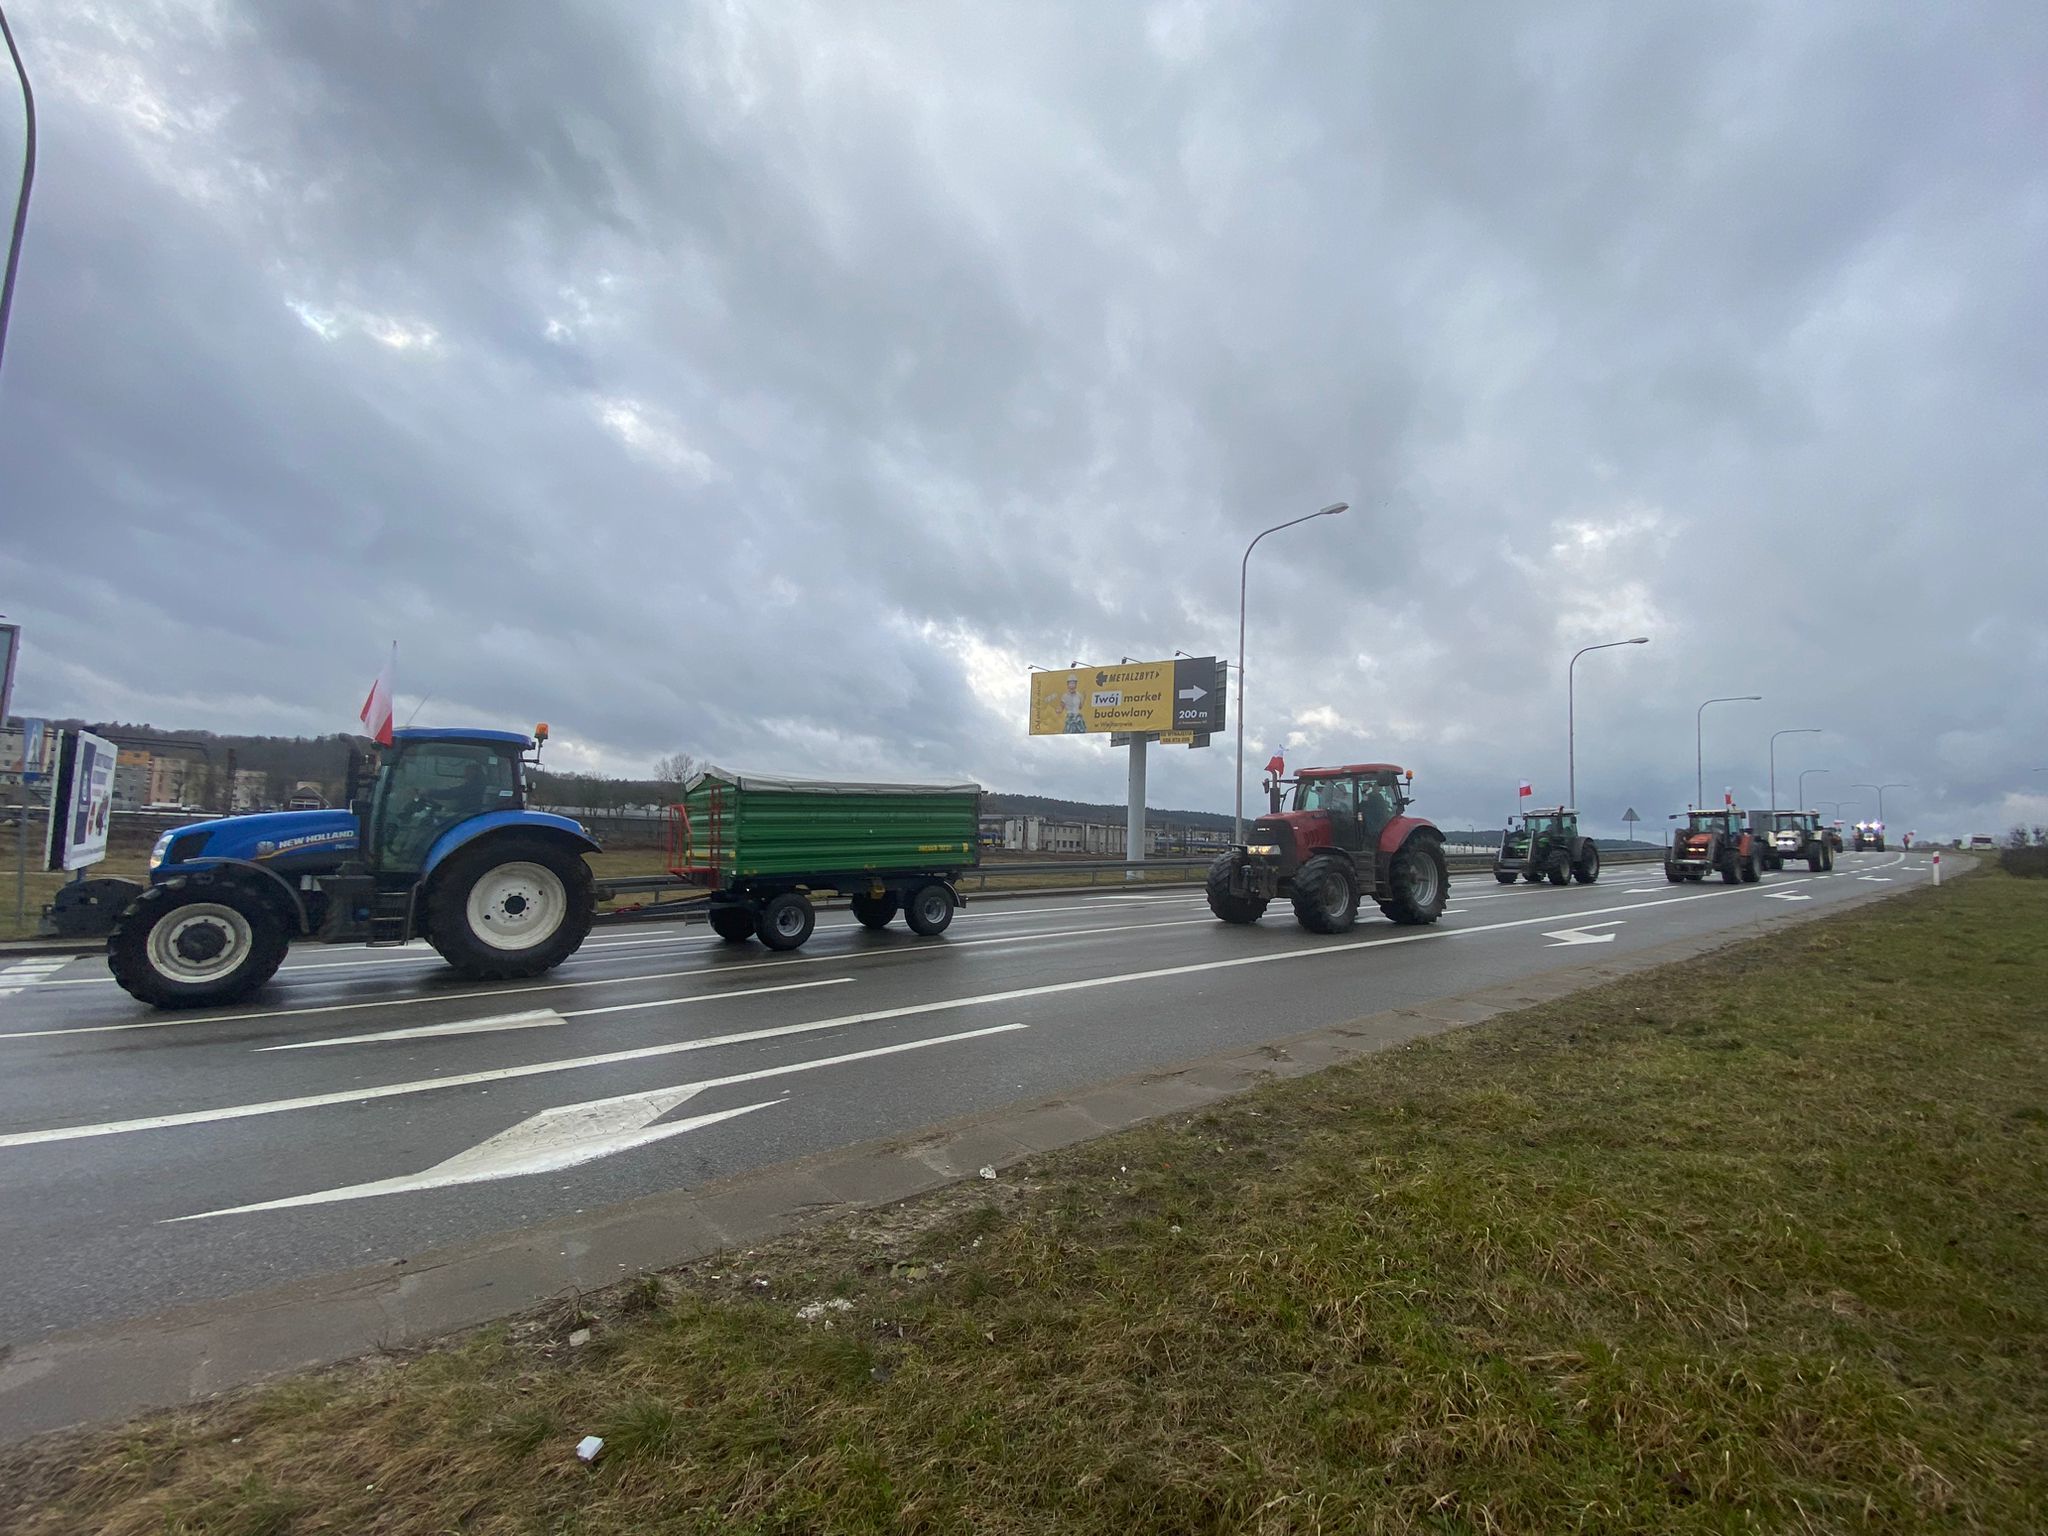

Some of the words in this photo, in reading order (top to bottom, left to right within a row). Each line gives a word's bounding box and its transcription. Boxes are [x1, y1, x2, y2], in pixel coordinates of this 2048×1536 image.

[1109, 671, 1155, 682] METALZBYT
[1094, 693, 1119, 705] Twój
[1124, 691, 1162, 702] market
[1094, 707, 1153, 719] budowlany
[1179, 710, 1197, 719] 200
[279, 837, 304, 848] NEW
[306, 830, 354, 843] HOLLAND
